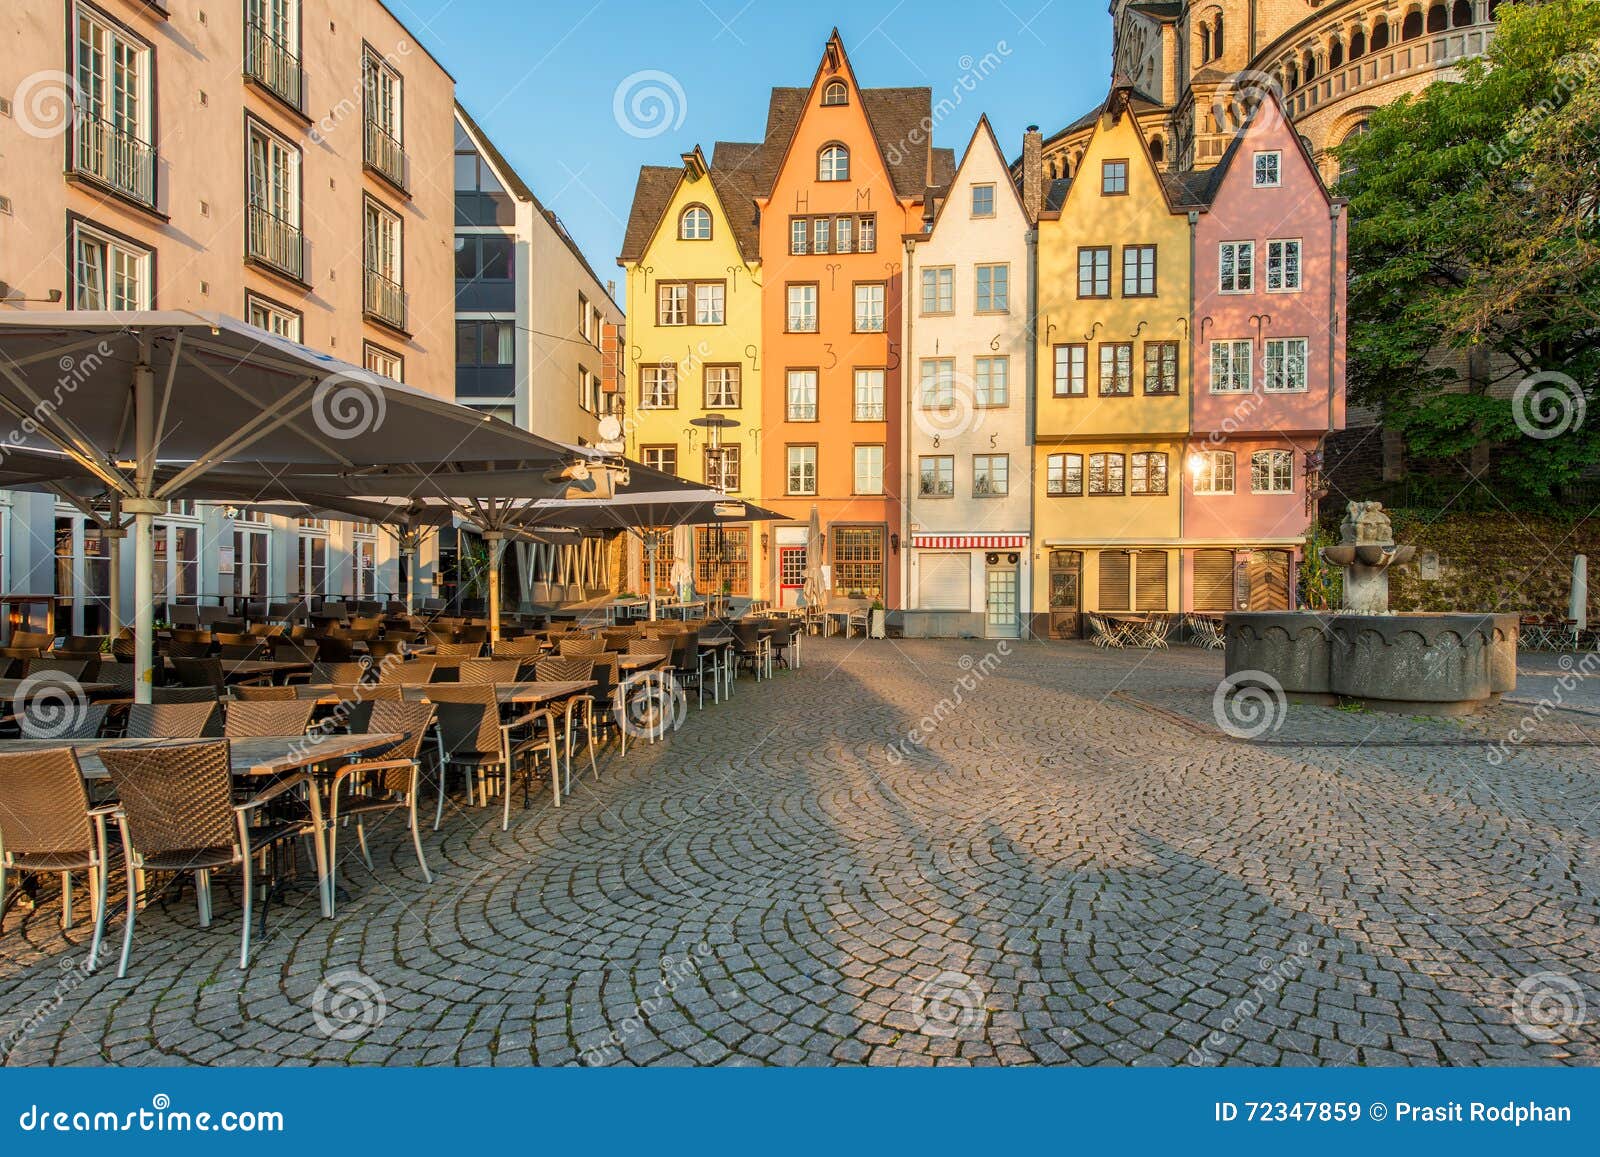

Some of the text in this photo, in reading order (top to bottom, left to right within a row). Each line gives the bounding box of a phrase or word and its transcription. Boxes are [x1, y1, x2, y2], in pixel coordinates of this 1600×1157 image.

[796, 188, 870, 213] H M
[990, 334, 1001, 351] 6
[823, 343, 838, 369] 3
[886, 343, 901, 371] 5
[932, 433, 998, 449] 8 5
